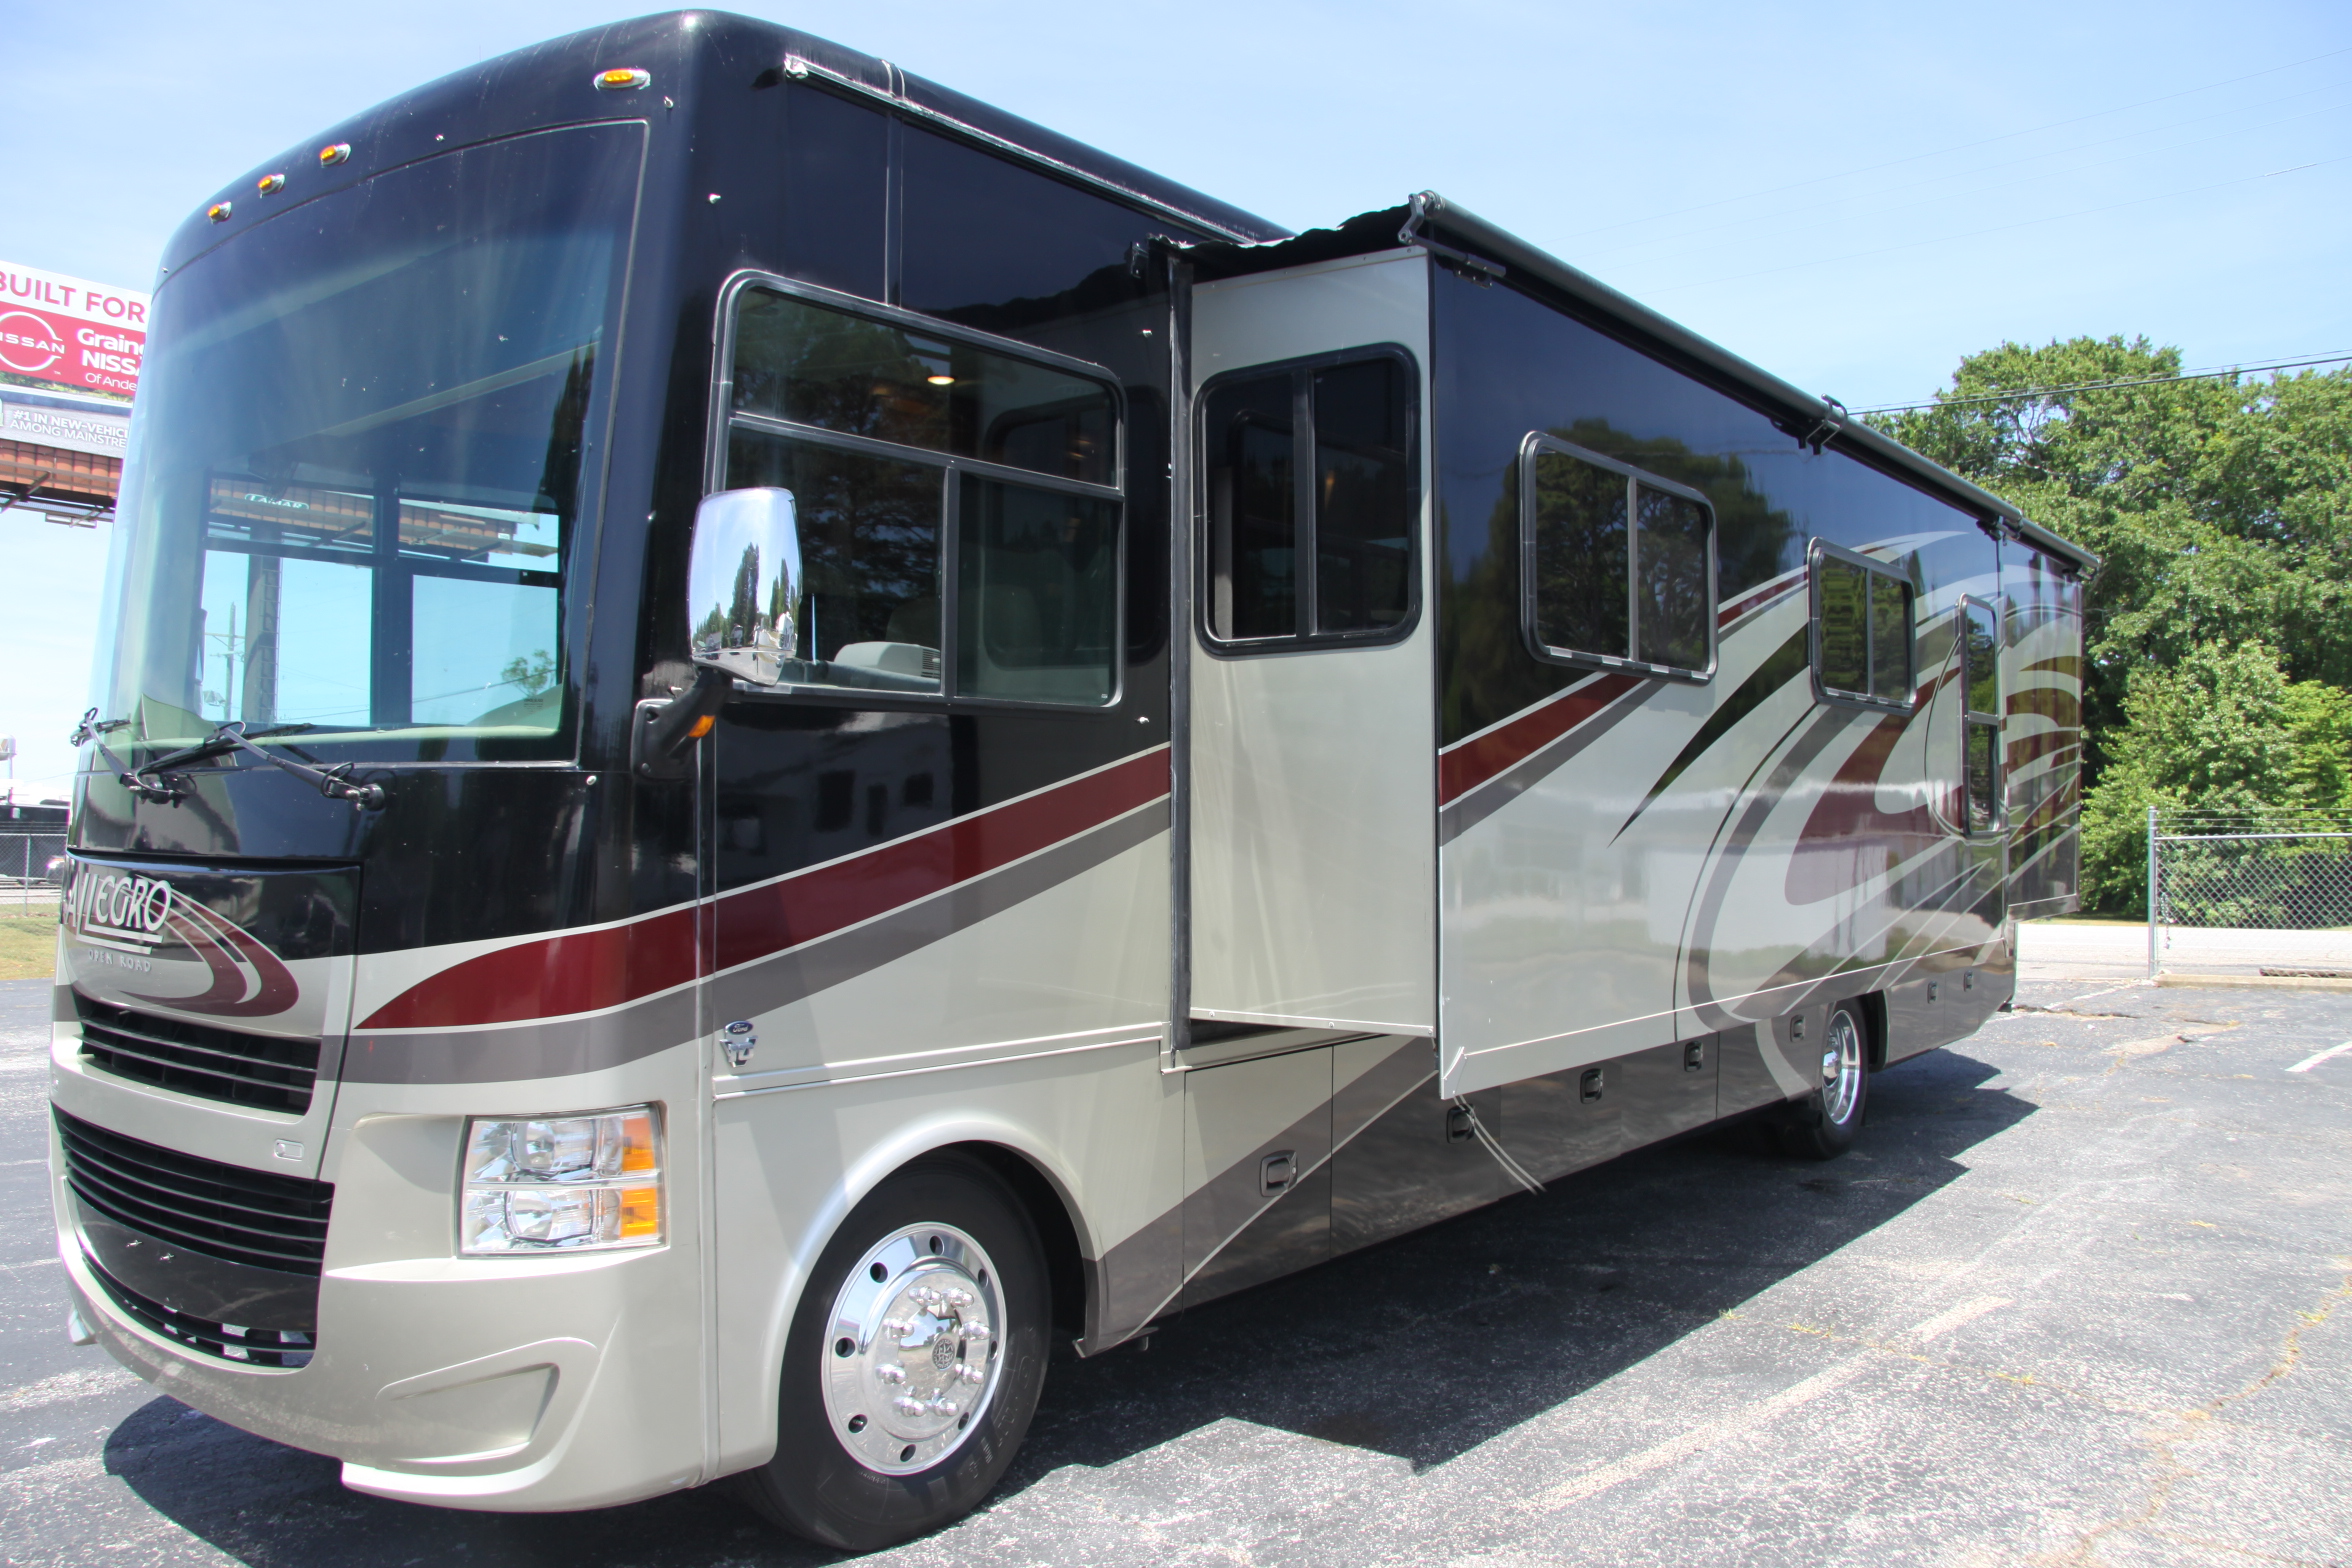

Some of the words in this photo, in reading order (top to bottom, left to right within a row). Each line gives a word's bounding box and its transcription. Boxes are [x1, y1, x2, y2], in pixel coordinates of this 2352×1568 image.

[86, 291, 146, 324] FOR
[0, 331, 66, 355] ISSAN
[81, 349, 140, 377] NISS
[85, 372, 102, 384] Of
[13, 409, 31, 422] #1
[34, 412, 48, 425] IN
[10, 419, 61, 437] AMONG
[64, 428, 127, 449] MAINSTRE
[62, 872, 172, 953] ALLEGRO
[88, 949, 114, 965] OPEN
[120, 955, 152, 972] ROAD
[732, 1023, 749, 1033] Ford
